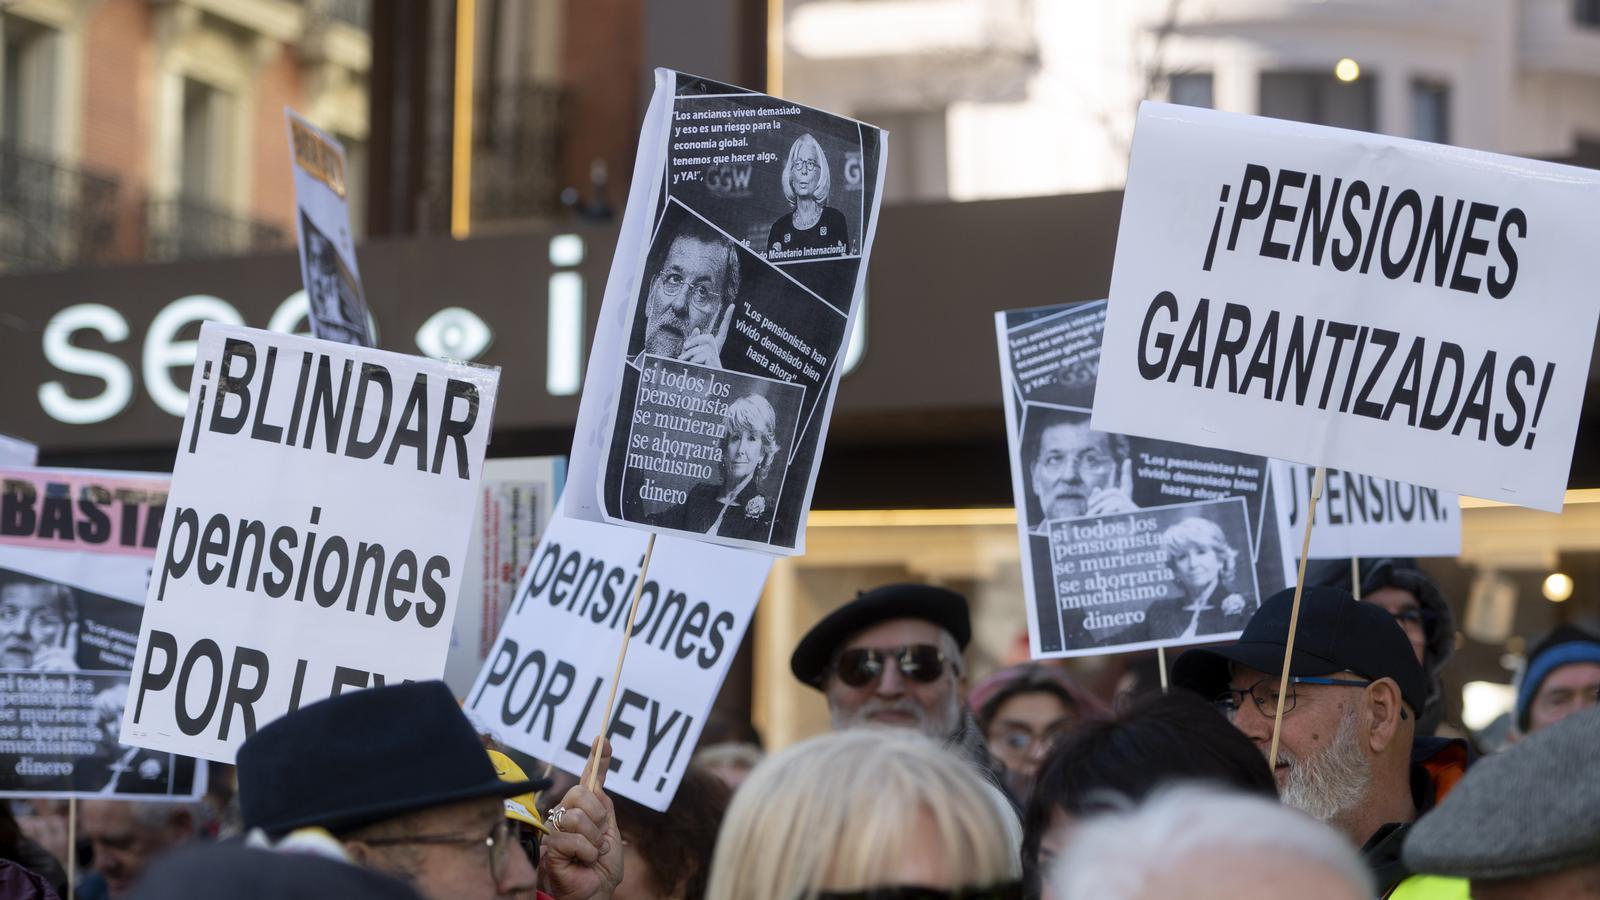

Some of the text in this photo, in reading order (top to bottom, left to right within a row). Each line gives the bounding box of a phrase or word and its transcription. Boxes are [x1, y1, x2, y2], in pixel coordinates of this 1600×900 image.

[692, 110, 731, 120] ancianos
[733, 107, 756, 118] viven
[757, 105, 801, 116] demasiado
[675, 120, 781, 137] y eso es un riesgo para la
[673, 151, 778, 166] tenemos que hacer algo,
[718, 137, 748, 151] global.
[673, 173, 680, 184] y
[1203, 163, 1527, 299] ¡PENSIONES
[769, 248, 802, 260] Monetario
[803, 243, 847, 257] Internacional
[744, 301, 828, 367] "Los pensionistas han
[735, 319, 821, 382] vivido demasiado bien
[746, 345, 769, 368] hasta
[643, 362, 731, 398] si todos los
[1137, 291, 1555, 450] GARANTIZADAS!
[188, 338, 480, 480] ¡BLINDAR
[640, 386, 735, 417] pensionista
[634, 409, 727, 439] se murieran
[632, 433, 649, 450] se
[640, 479, 687, 504] dinero
[1053, 514, 1158, 543] si todos los
[158, 507, 450, 628] pensiones
[1055, 549, 1169, 576] se murieran
[1059, 579, 1081, 595] se
[516, 541, 734, 670] pensiones
[1082, 609, 1146, 631] dinero
[133, 629, 269, 741] POR
[472, 638, 577, 742] POR
[565, 677, 693, 792] LEY!
